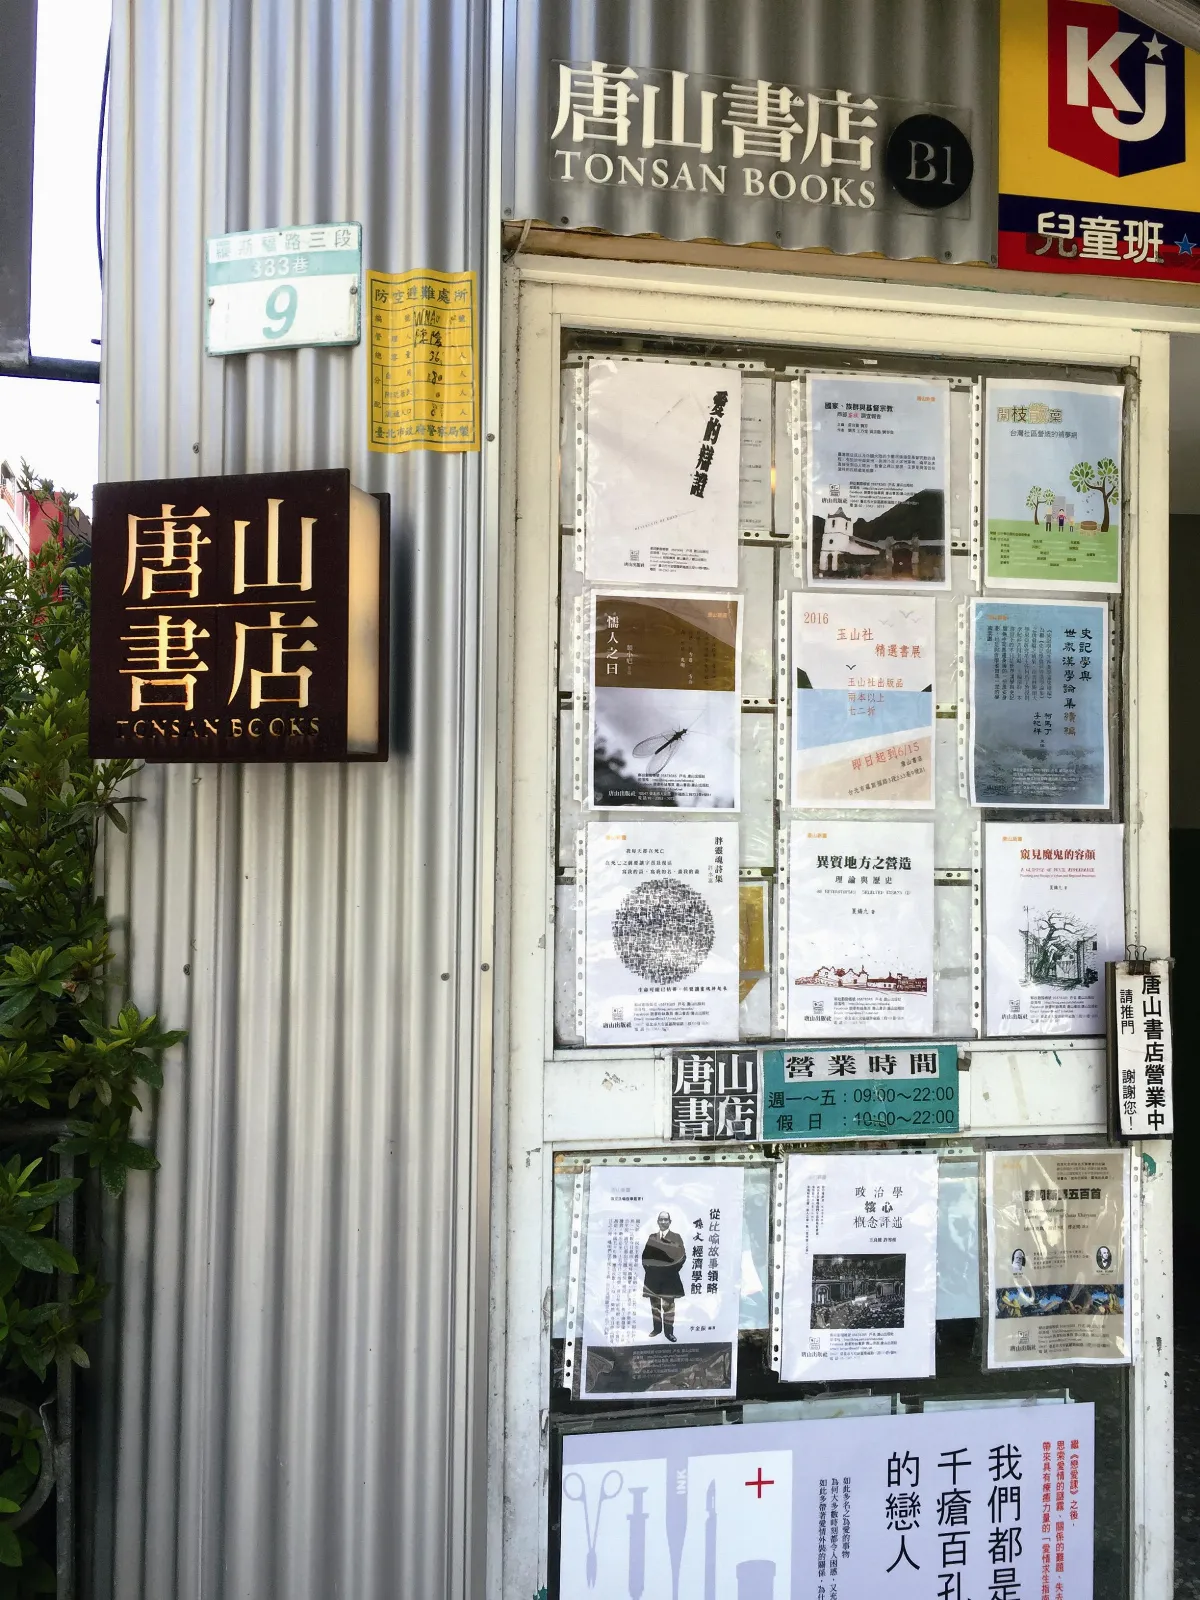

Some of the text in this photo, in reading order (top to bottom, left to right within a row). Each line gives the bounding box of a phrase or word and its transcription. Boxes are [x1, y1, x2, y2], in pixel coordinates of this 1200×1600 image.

[550, 60, 879, 172] 唐山書店
[907, 139, 955, 186] B1
[554, 149, 877, 209] TONSAN BOOKS
[1035, 211, 1165, 264] 兒童班
[252, 256, 309, 279] 333巷
[374, 285, 469, 305] 防空避難處所
[262, 284, 298, 340] 9
[996, 401, 1063, 425] 開枝散葉
[1010, 429, 1078, 440] 台灣社區營造的捕夢網
[121, 498, 318, 600] 唐山
[803, 611, 829, 625] 2016
[836, 628, 875, 641] 玉山社
[118, 611, 319, 712] 書店
[875, 644, 922, 659] 精選書展
[847, 677, 904, 688] 玉山社出版品
[116, 717, 320, 739] TONSAN BOOKS
[851, 741, 920, 771] 即日起到6/15
[714, 836, 724, 884] 胖靈魂詩集
[816, 855, 912, 870] 異質地方之營造
[1020, 848, 1096, 861] 窺見魔鬼的容顏
[835, 875, 893, 885] 理論與歷史
[1119, 989, 1135, 1035] 請推門
[785, 1052, 938, 1079] 營業時間
[1141, 973, 1168, 1132] 唐山書店營業中
[674, 1054, 754, 1095] 唐山
[673, 1096, 755, 1138] 書店
[854, 1185, 904, 1199] 政治學
[864, 1200, 894, 1214] 核心
[852, 1215, 903, 1229] 概念評述
[706, 1208, 721, 1295] 從比喻故事領略
[676, 1468, 687, 1495] INK
[841, 1476, 851, 1559] 如此多名之為愛的事物
[885, 1450, 921, 1573] 的戀人
[936, 1447, 972, 1600] 千瘡百孔
[988, 1443, 1022, 1600] 我們都是
